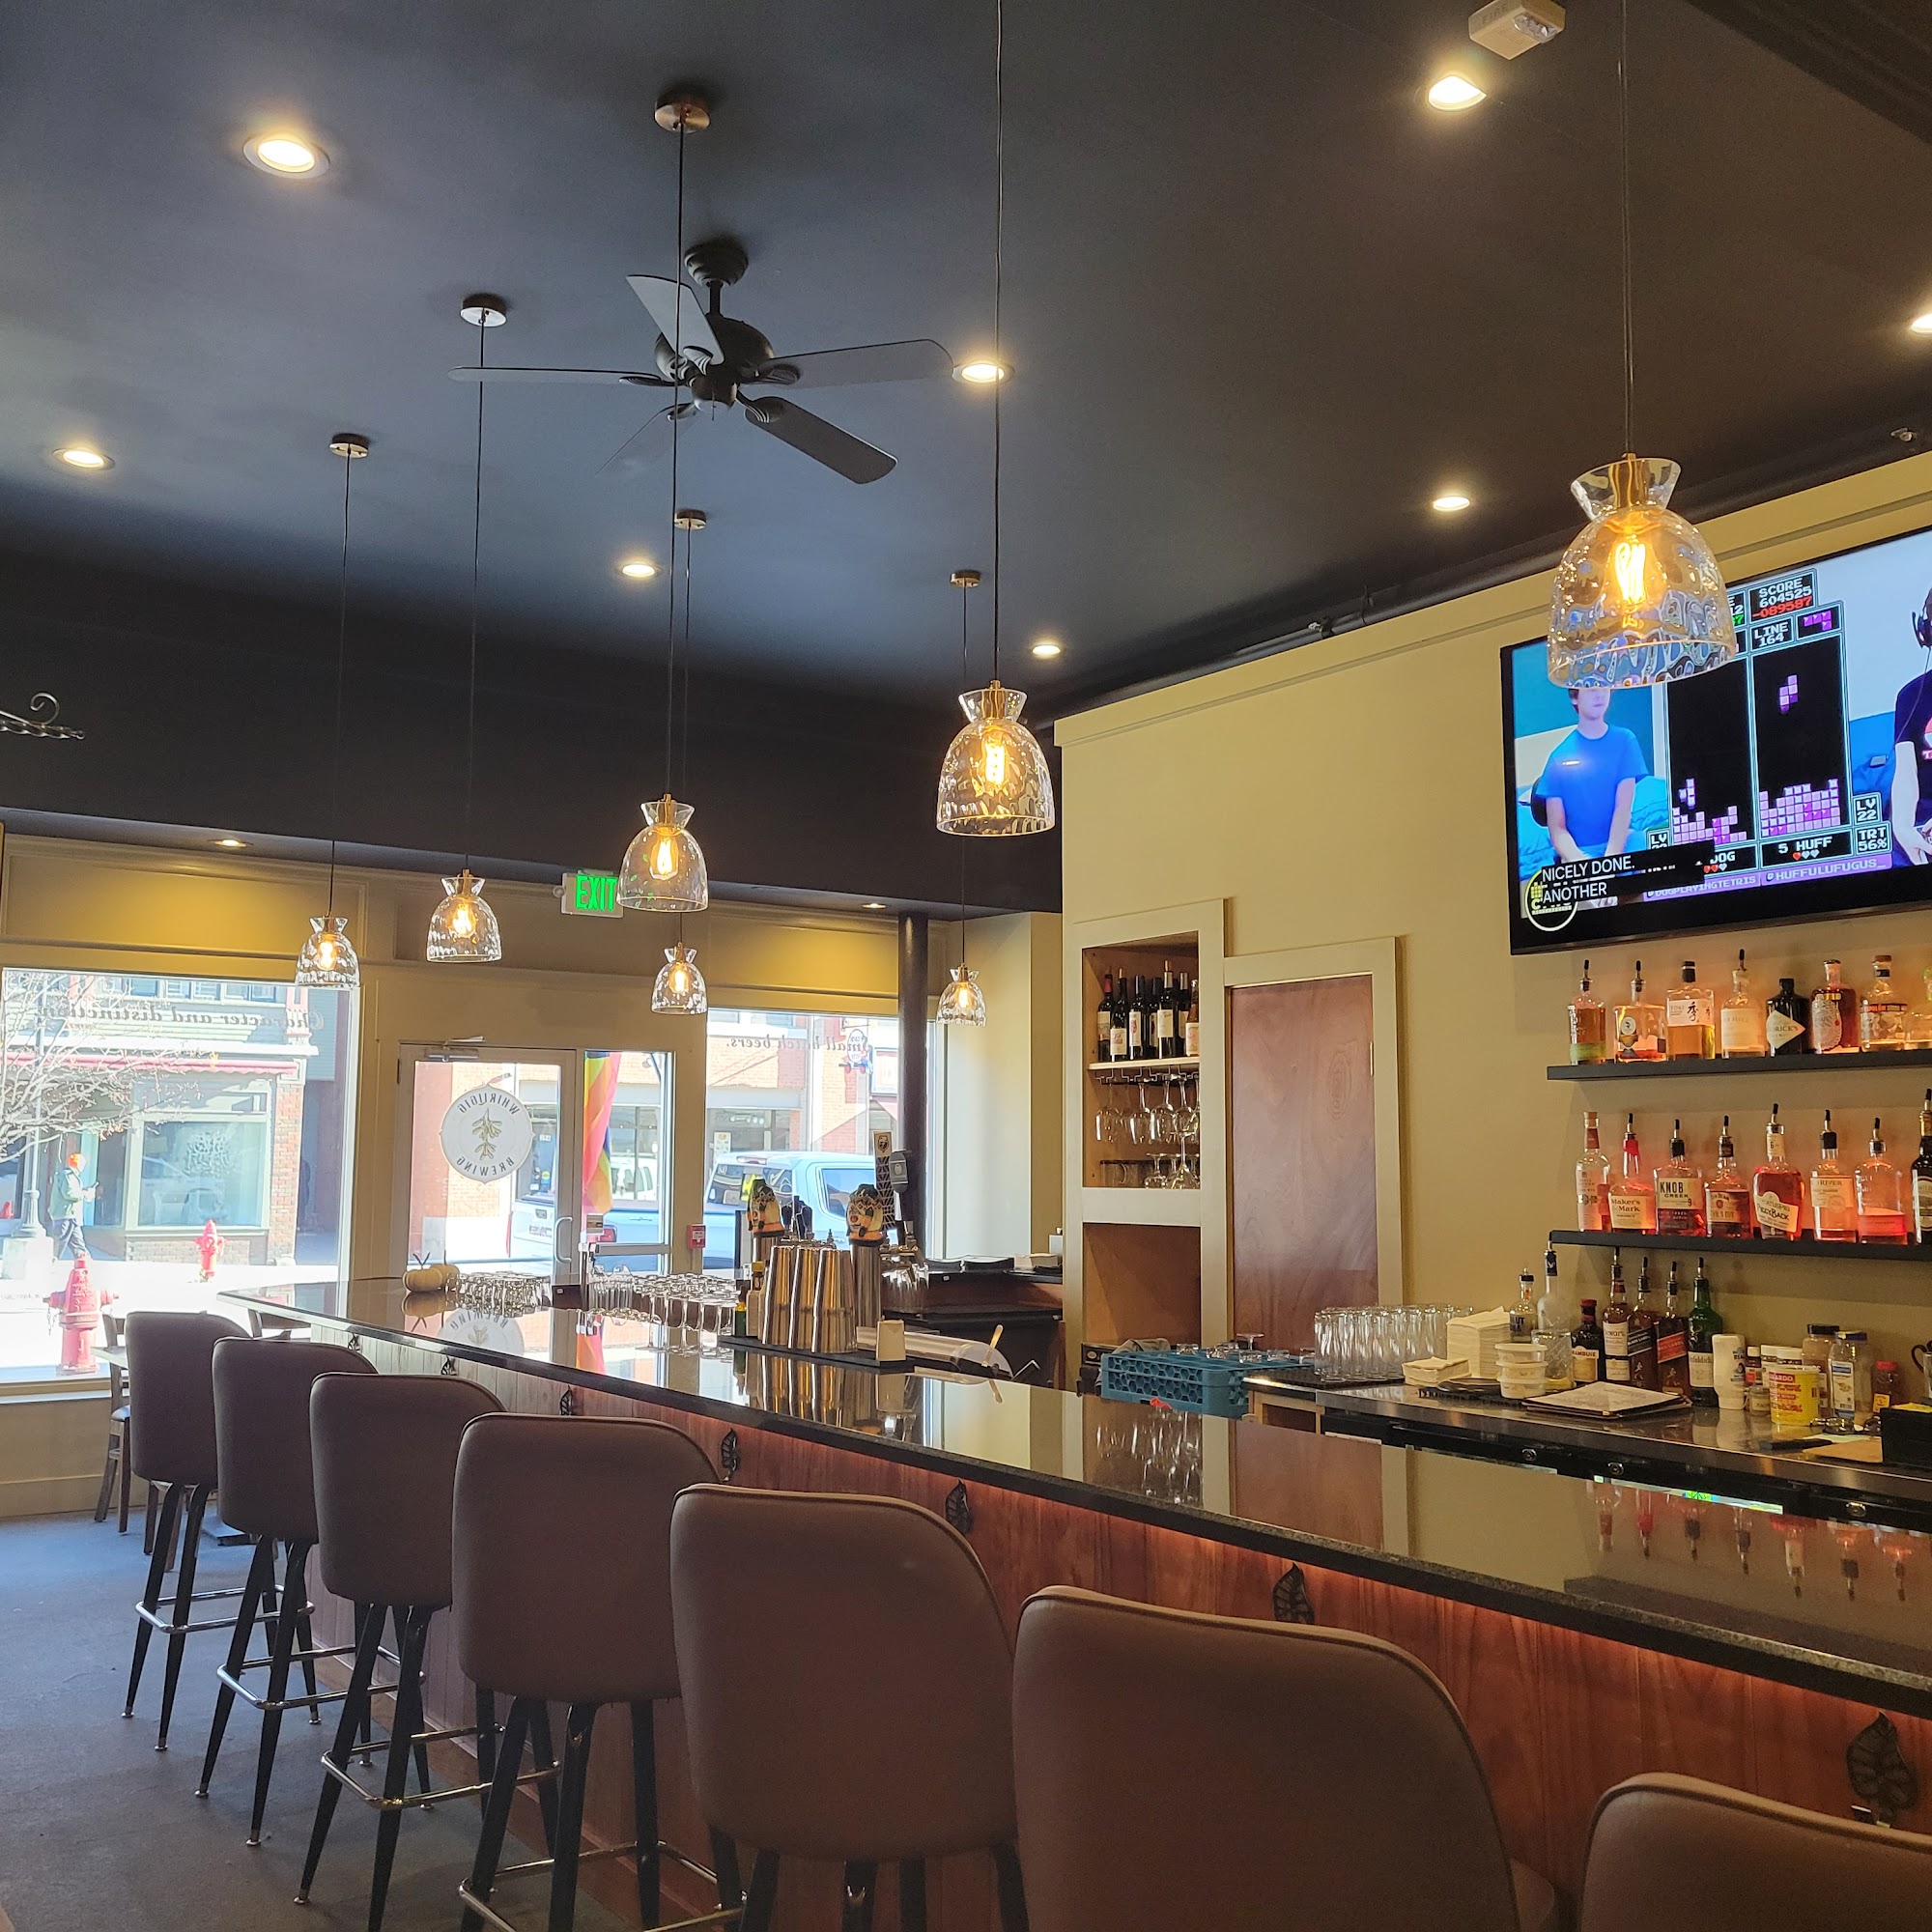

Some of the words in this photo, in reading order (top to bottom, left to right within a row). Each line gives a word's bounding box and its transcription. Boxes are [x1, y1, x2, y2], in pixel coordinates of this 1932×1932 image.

[1759, 578, 1804, 598] SCORE
[1759, 585, 1812, 609] 604525
[1754, 621, 1789, 639] LINE
[1758, 633, 1785, 647] 164
[1856, 798, 1877, 811] LV
[1857, 809, 1877, 822] 22
[1651, 834, 1667, 845] LV
[1858, 827, 1887, 841] TRT
[1777, 842, 1789, 854] 5
[1796, 836, 1833, 852] HUFF
[1858, 838, 1888, 852] 56%
[1542, 862, 1589, 883] NICELY
[1591, 855, 1635, 875] DONE.
[575, 874, 618, 912] EXIT
[1543, 881, 1608, 904] ANOTHER
[1660, 1181, 1684, 1194] KNOB
